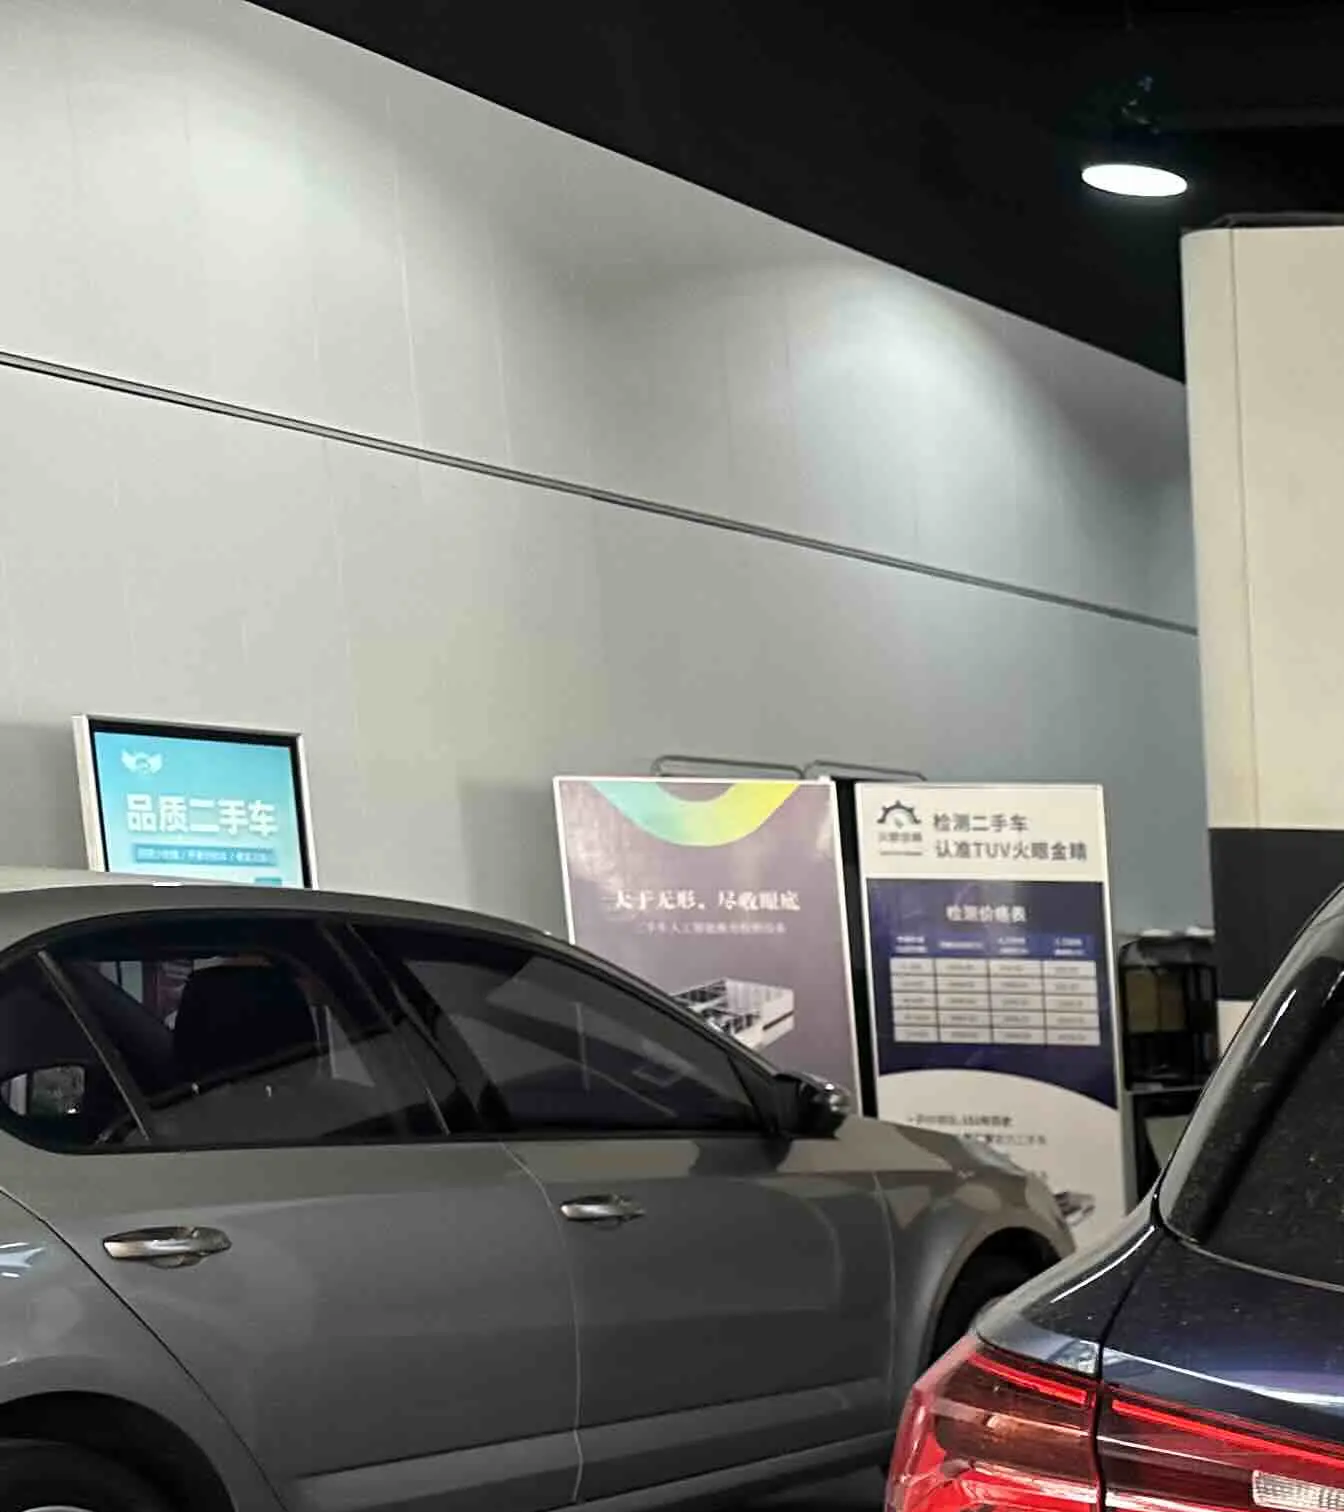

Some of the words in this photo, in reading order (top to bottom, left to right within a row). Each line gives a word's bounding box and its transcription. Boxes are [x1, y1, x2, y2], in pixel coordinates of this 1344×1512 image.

[126, 793, 279, 836] 品质二手车
[933, 813, 1029, 833] 检测二手车
